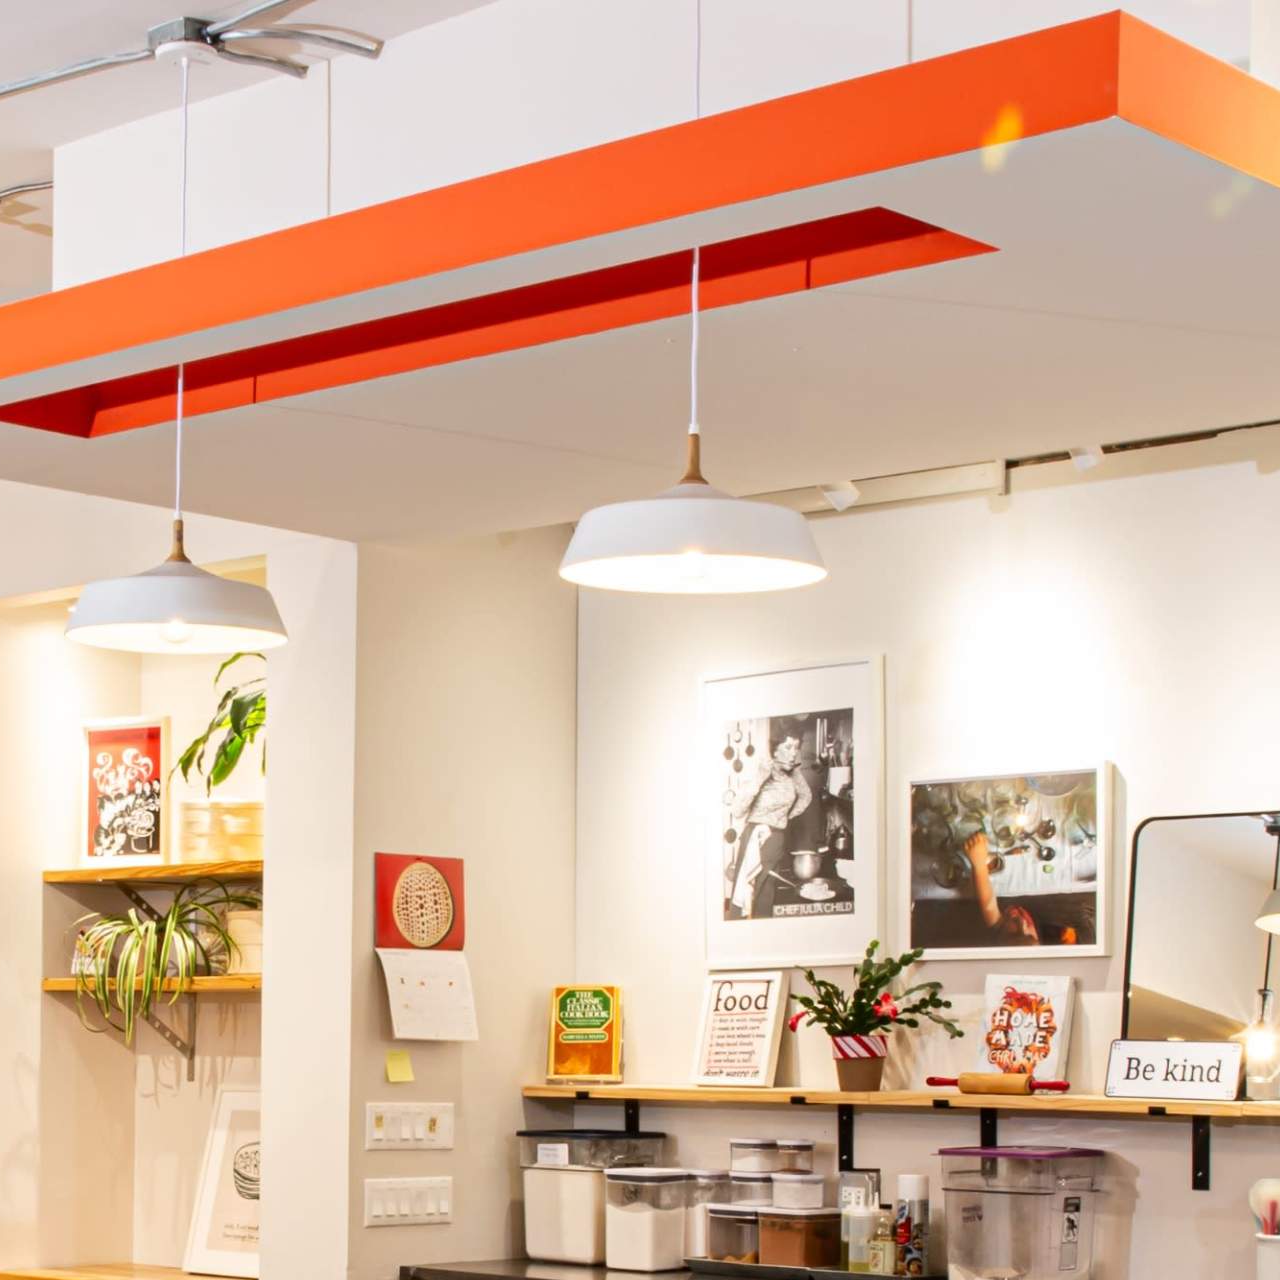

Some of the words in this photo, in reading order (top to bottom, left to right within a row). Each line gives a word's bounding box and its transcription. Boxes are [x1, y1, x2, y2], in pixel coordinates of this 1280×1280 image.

[773, 904, 799, 916] CHEF
[824, 901, 852, 912] CHILD
[713, 980, 770, 1011] food
[993, 1009, 1051, 1028] HOME
[991, 1030, 1047, 1047] MADE
[988, 1049, 1049, 1064] CHRIMAS
[1123, 1056, 1156, 1081] Be
[1162, 1057, 1223, 1083] kind
